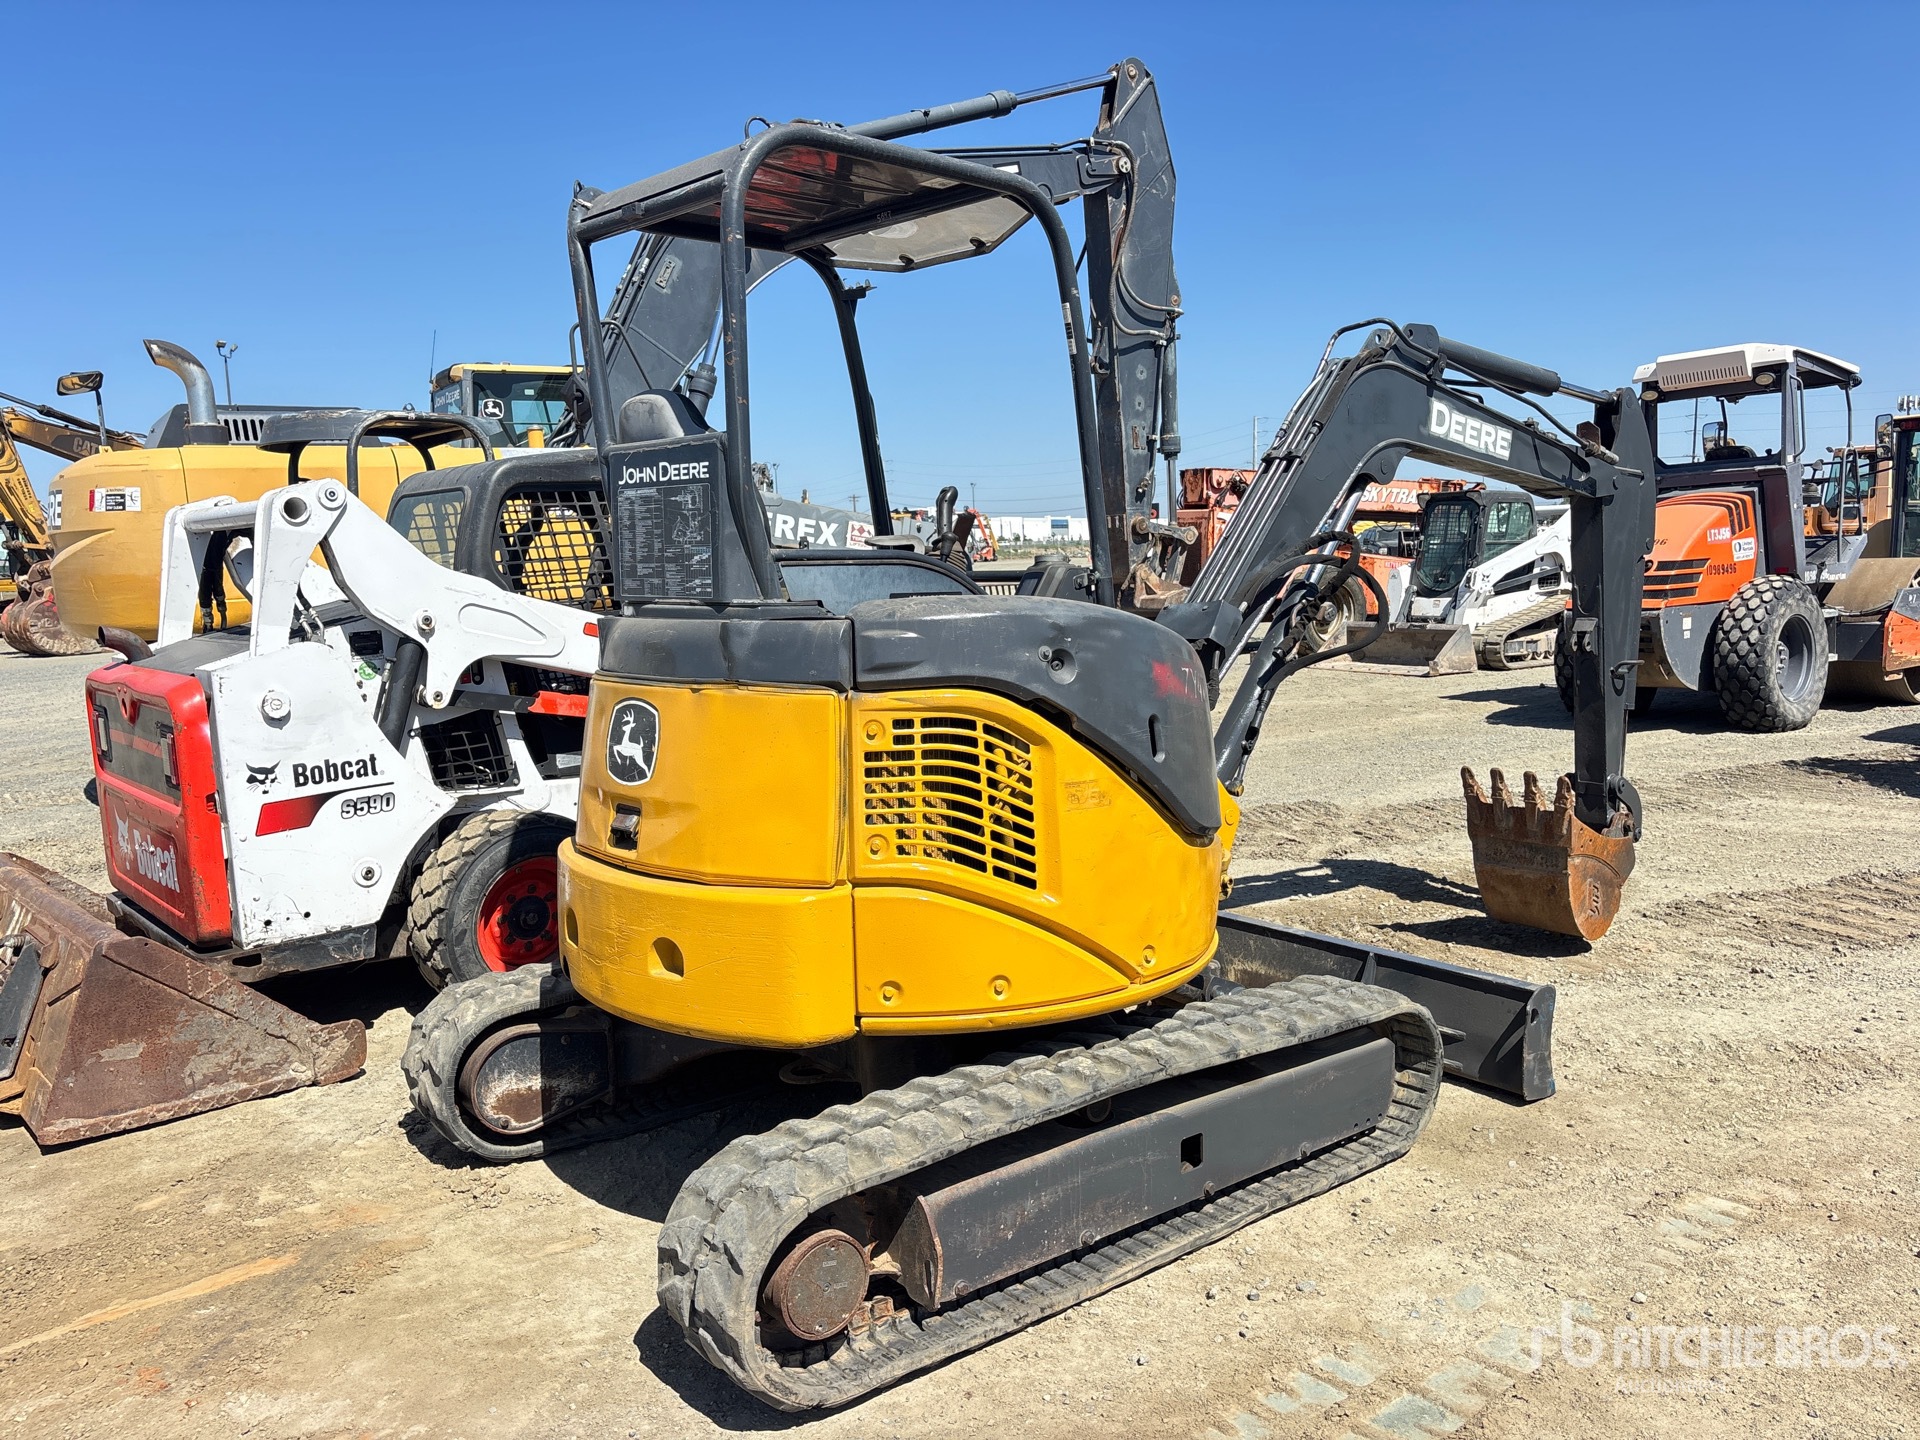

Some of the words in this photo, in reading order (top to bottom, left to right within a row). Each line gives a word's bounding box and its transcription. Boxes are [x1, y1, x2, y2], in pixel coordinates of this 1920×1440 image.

[434, 394, 446, 409] JOHN
[446, 389, 460, 404] DEERE
[1430, 400, 1512, 460] DEERE
[73, 437, 98, 456] CAT
[618, 465, 657, 485] JOHN
[658, 461, 710, 482] DEERE
[292, 753, 379, 788] Bobcat
[341, 792, 396, 819] S590
[133, 829, 180, 893] Bobcat
